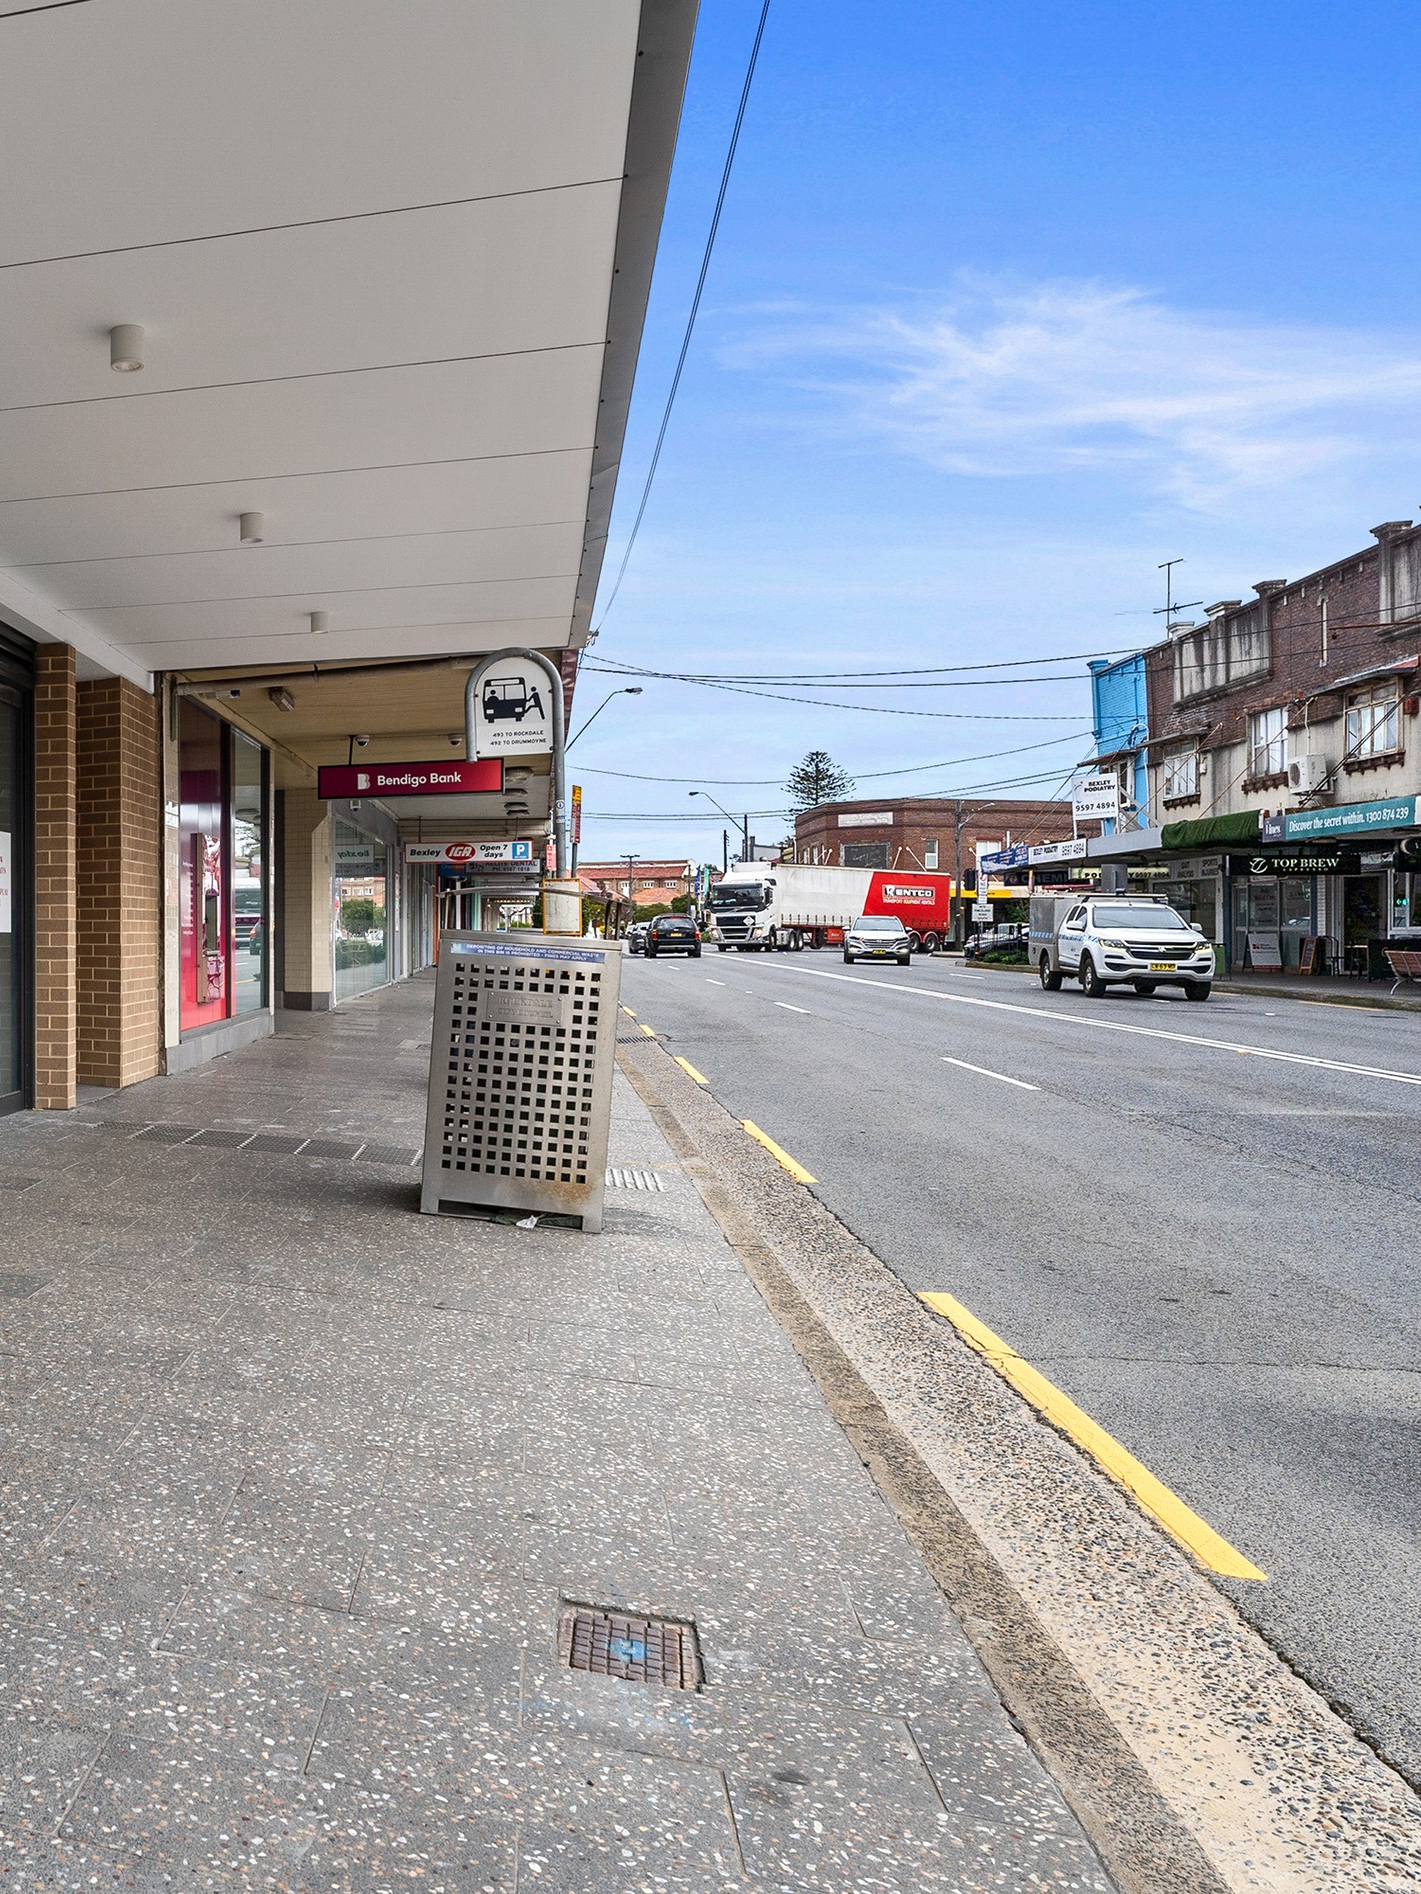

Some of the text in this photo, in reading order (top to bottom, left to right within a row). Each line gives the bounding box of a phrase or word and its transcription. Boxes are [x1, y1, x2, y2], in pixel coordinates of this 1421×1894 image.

[377, 774, 427, 788] Bendigo
[430, 772, 462, 784] Bank
[1084, 785, 1116, 793] PODIATRY
[1075, 801, 1115, 812] 9597 4894
[1289, 806, 1409, 833] Discover the secret within. 1300 874 239
[409, 845, 471, 858] Bexley IGA
[480, 844, 501, 853] Open
[516, 844, 525, 856] P
[484, 851, 504, 859] days
[1271, 858, 1340, 868] TOP BREW
[886, 885, 933, 898] RENTCO
[504, 946, 535, 954] HOUSEHOLD
[499, 997, 553, 1008] ROCKDALE
[498, 1008, 553, 1019] CITY COUNCIL
